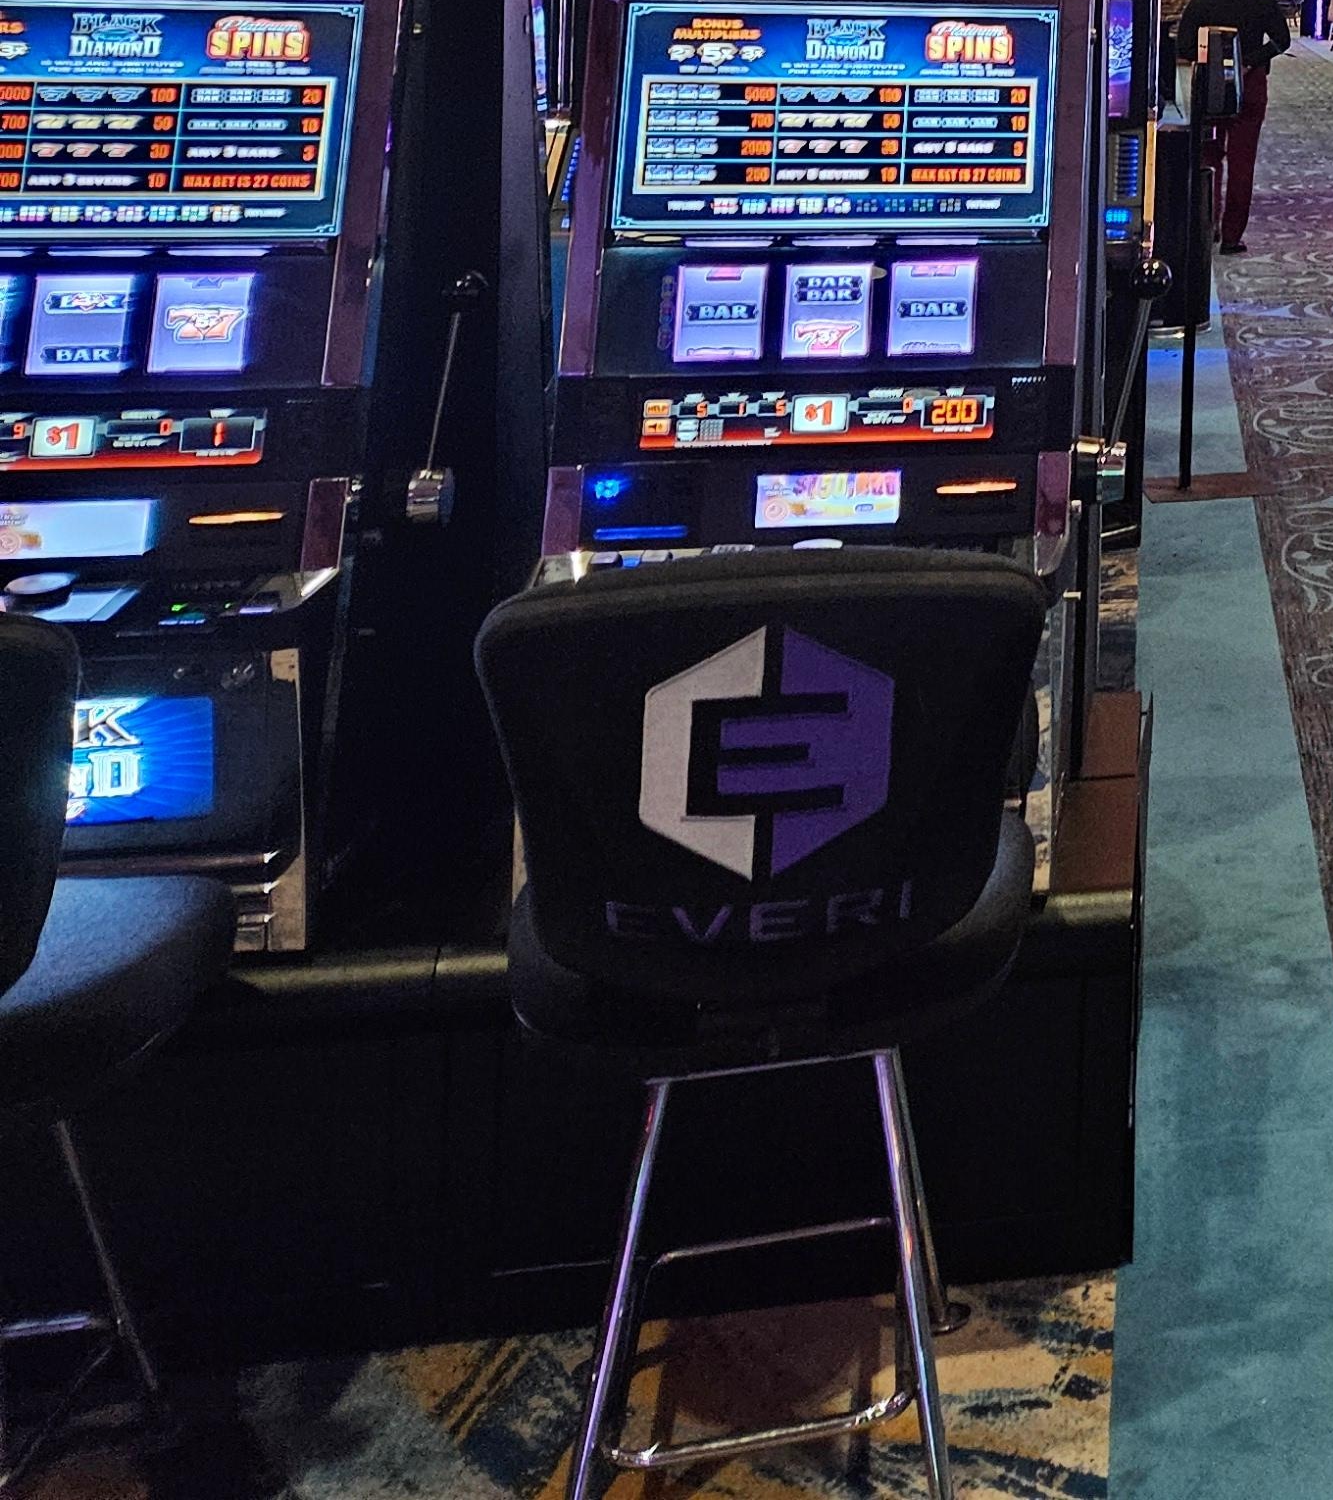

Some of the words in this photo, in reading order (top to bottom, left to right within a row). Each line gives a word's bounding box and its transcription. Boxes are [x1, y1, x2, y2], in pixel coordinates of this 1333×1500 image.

[72, 13, 165, 35] BLACK
[692, 19, 744, 29] BONUS
[807, 19, 888, 39] BLACK
[673, 28, 763, 40] MULTIPLIERS
[69, 35, 163, 57] DIAMOND
[806, 40, 885, 60] DIAMOND
[2, 115, 28, 130] 700
[153, 115, 174, 131] 50
[150, 143, 170, 159] 30
[148, 173, 167, 188] 10
[183, 174, 212, 188] MAX
[213, 175, 236, 188] BET
[253, 175, 269, 188] 27
[270, 174, 311, 188] COINS
[807, 276, 853, 288] BAR
[807, 288, 853, 301] BAR
[699, 304, 748, 318] BAR
[910, 301, 958, 316] BAR
[55, 348, 110, 362] BAR
[804, 400, 833, 426] $1
[931, 400, 977, 425] 200
[46, 423, 79, 450] $1
[605, 880, 913, 944] EVERI
